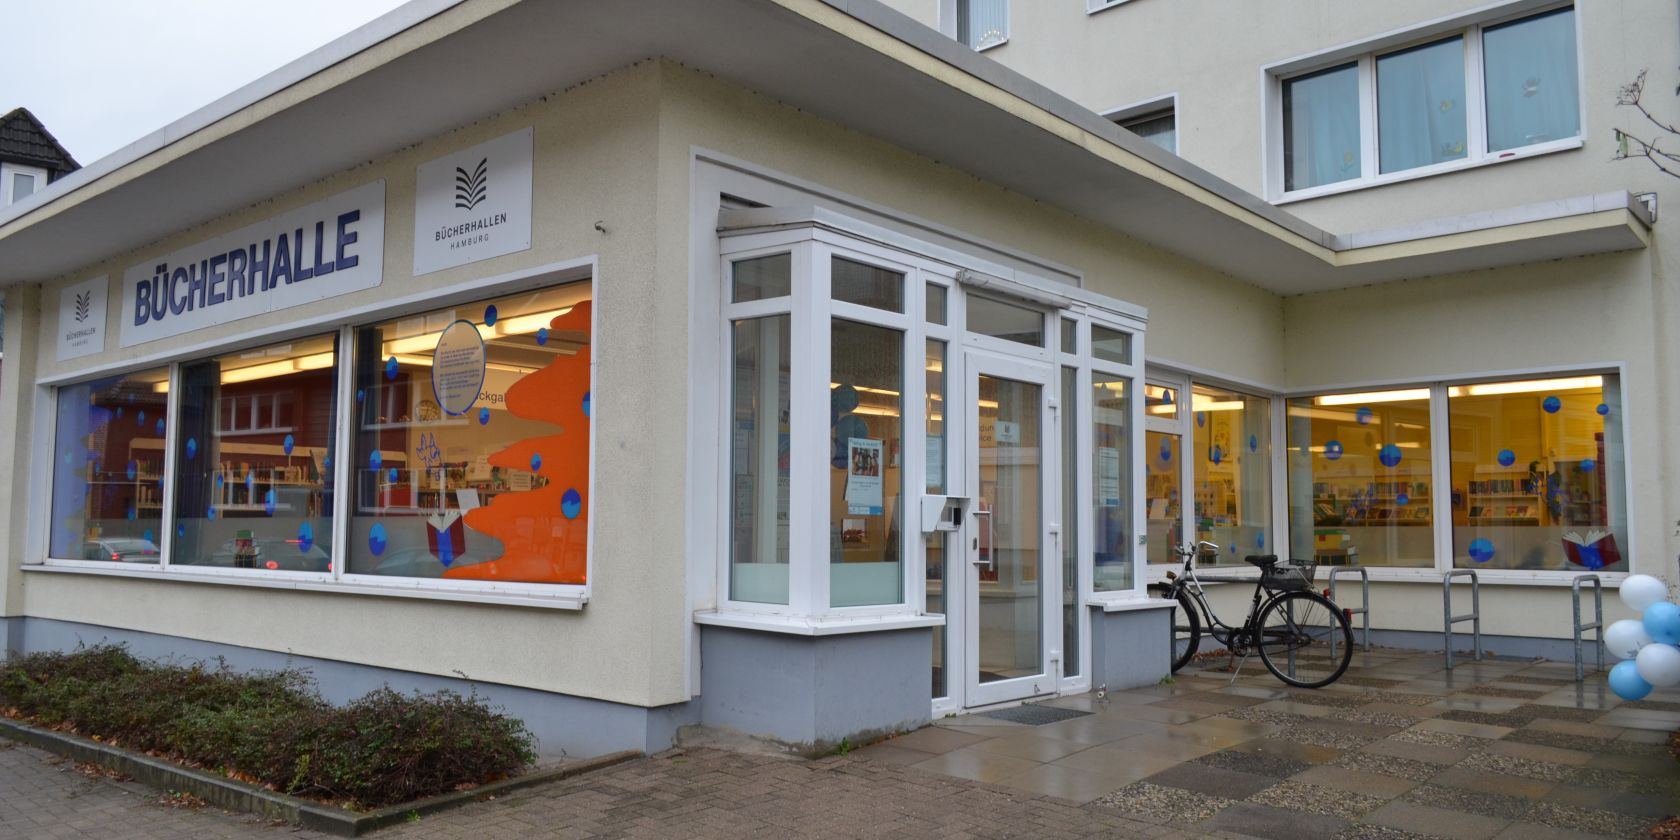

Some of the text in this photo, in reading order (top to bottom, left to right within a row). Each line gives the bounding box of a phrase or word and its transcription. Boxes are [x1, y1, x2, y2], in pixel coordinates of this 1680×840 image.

[435, 212, 507, 241] BÜCHERHALLEN
[450, 233, 489, 251] HAMBURG
[134, 209, 360, 326] BÜCHERHALLE
[477, 391, 504, 404] ckga
